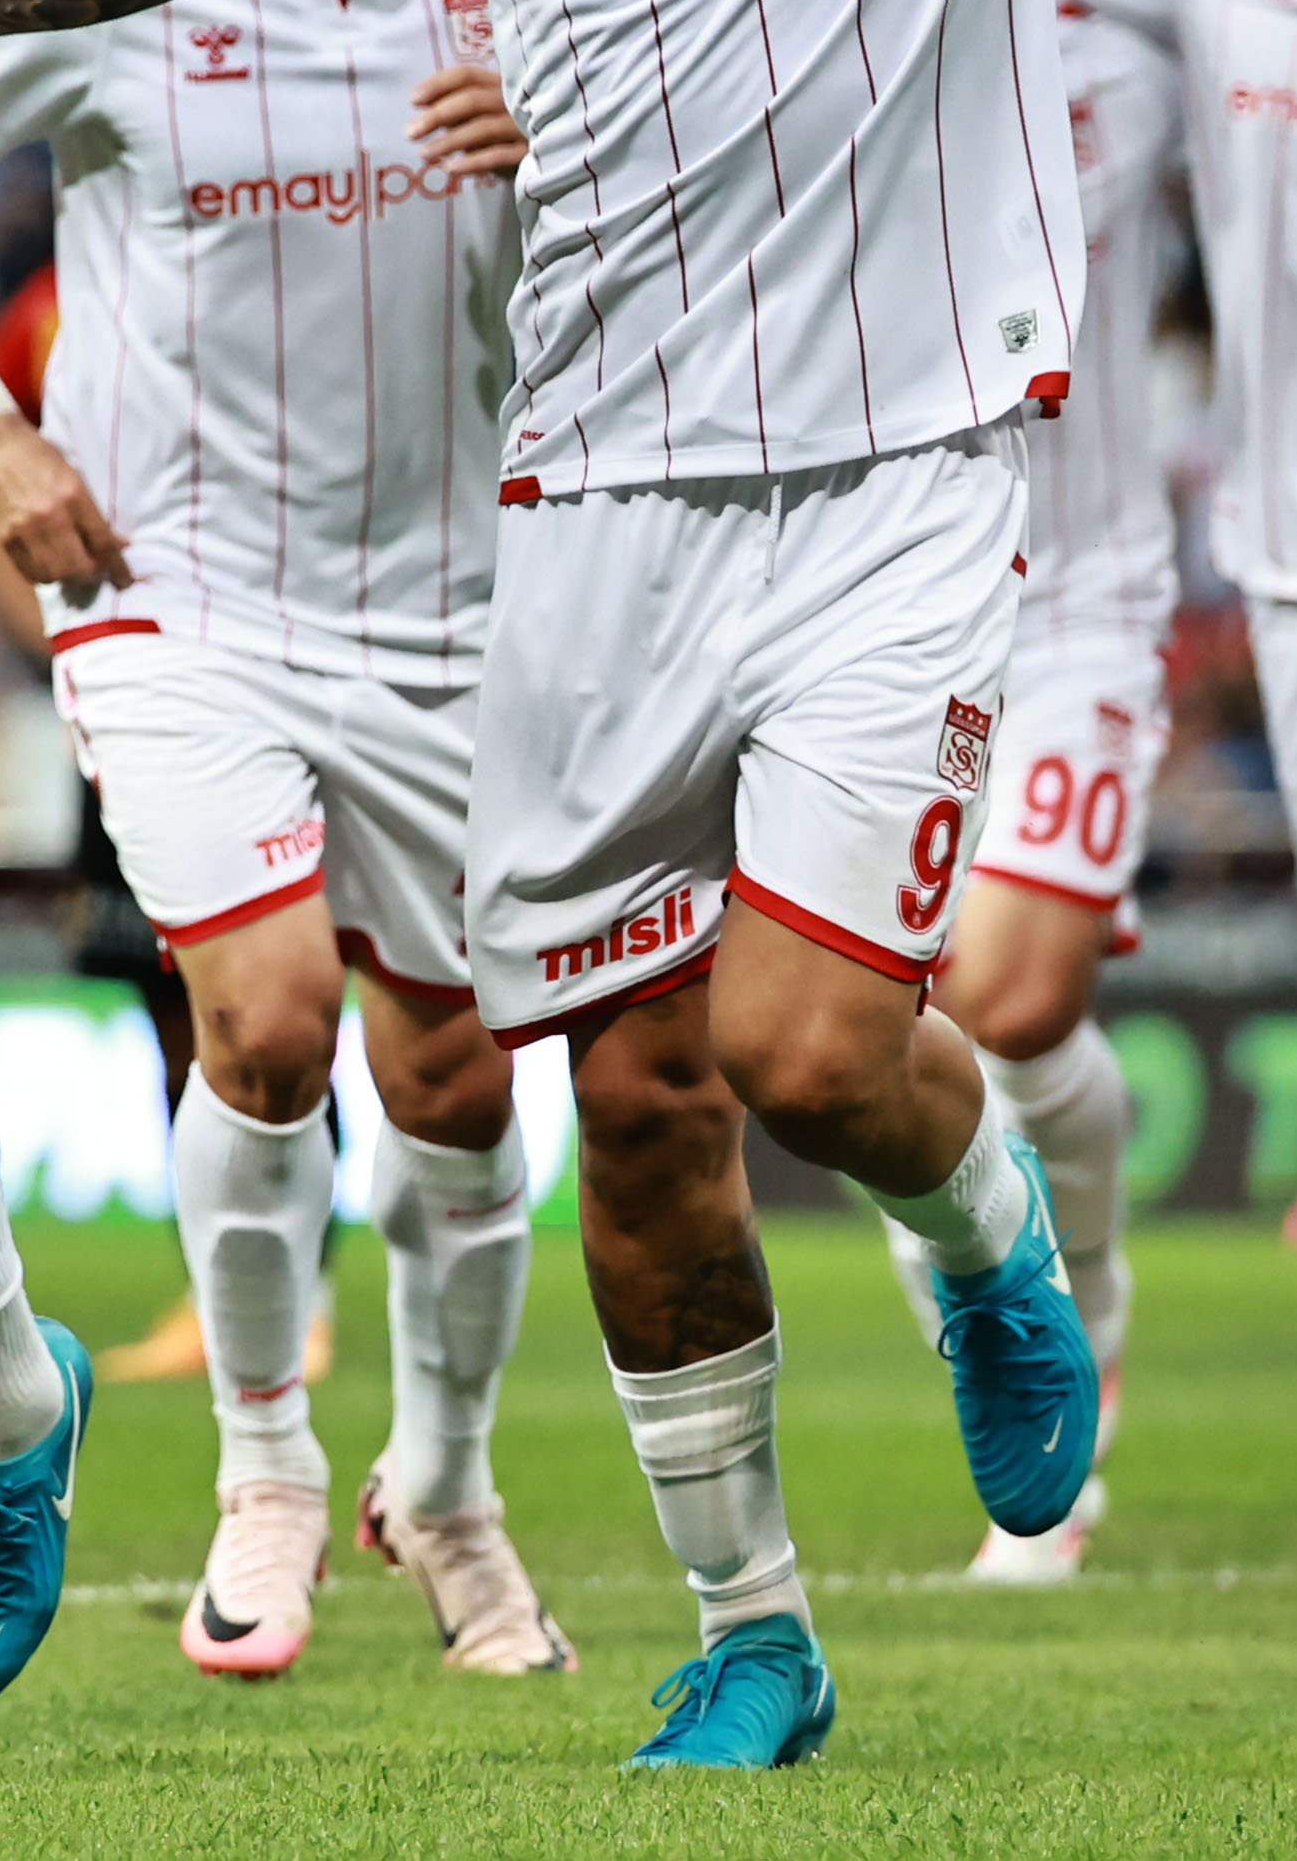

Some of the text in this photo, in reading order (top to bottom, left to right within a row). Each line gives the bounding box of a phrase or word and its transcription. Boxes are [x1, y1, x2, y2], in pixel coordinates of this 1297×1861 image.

[895, 794, 965, 935] 9
[1018, 755, 1128, 868] 90
[536, 887, 696, 982] misli
